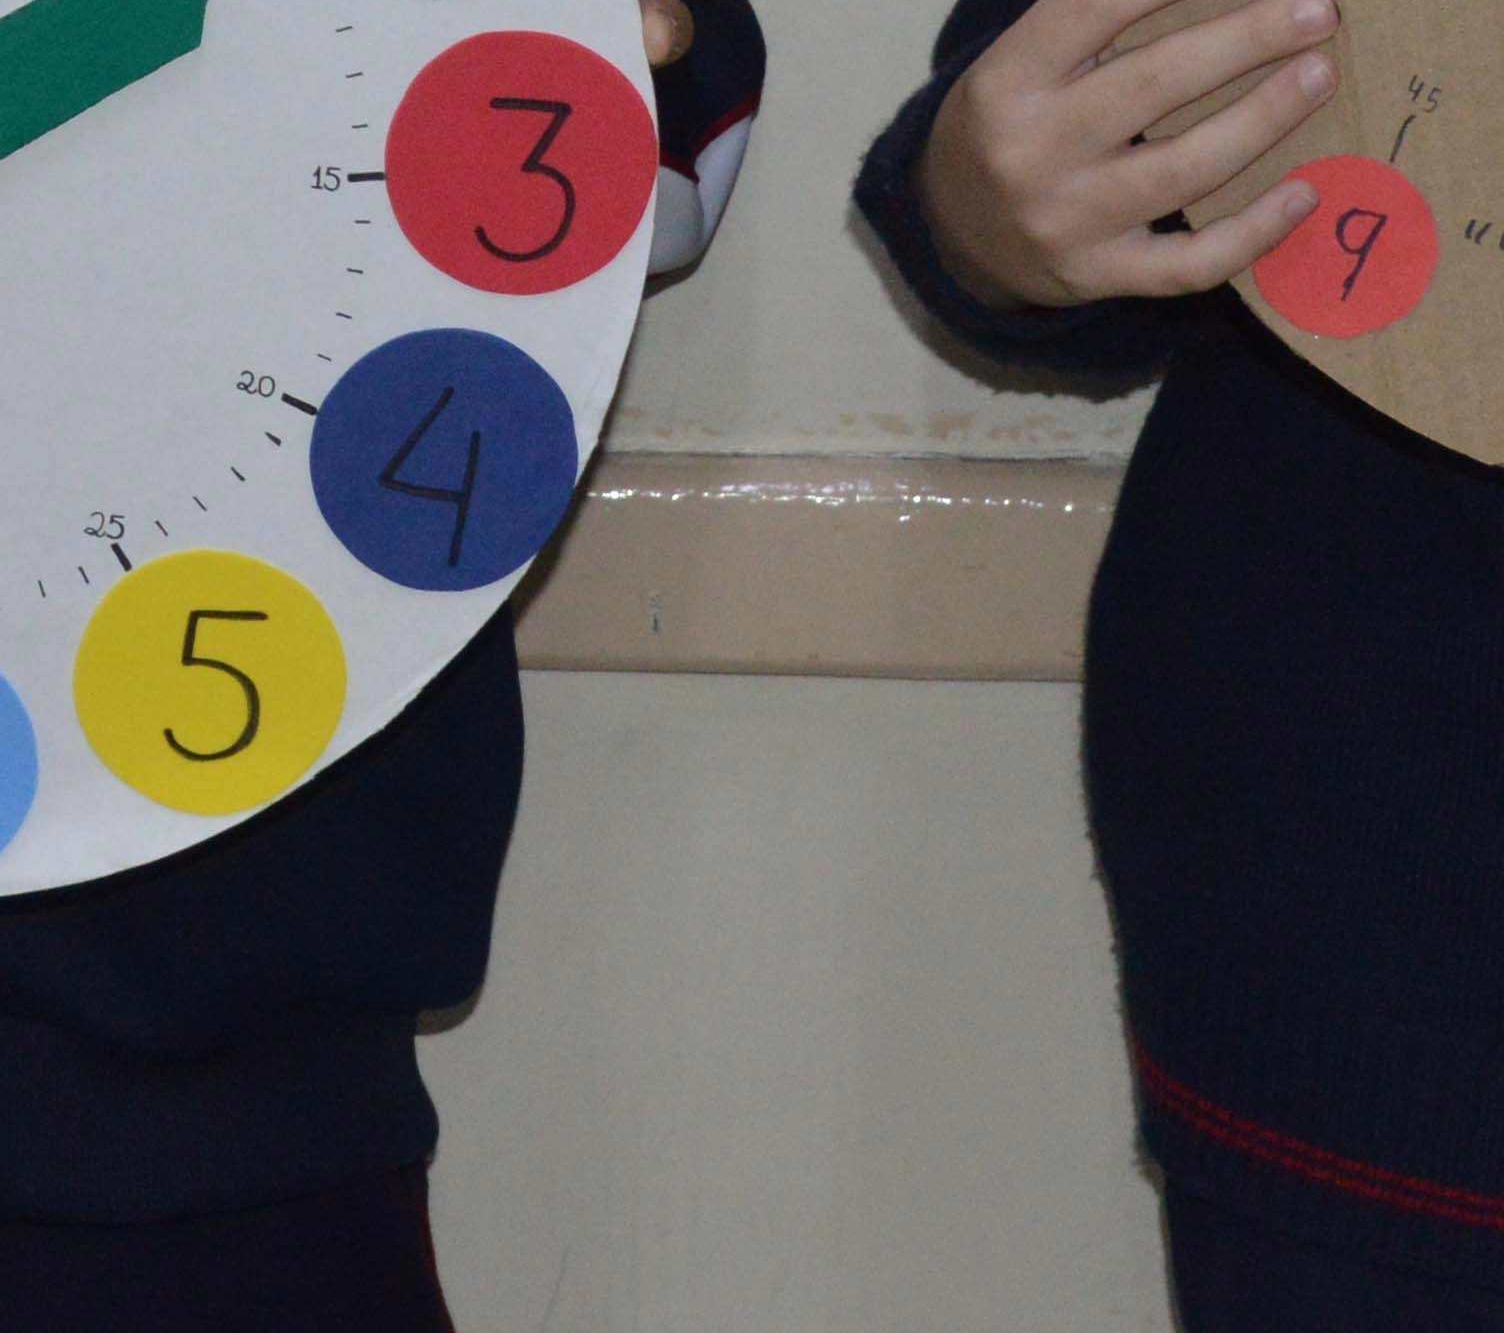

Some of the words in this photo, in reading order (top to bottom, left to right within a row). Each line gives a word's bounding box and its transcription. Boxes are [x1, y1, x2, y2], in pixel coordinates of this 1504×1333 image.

[1408, 74, 1442, 113] 45
[311, 166, 341, 193] 15
[474, 96, 576, 263] 3
[1335, 207, 1388, 300] 9
[236, 369, 276, 398] 20
[377, 386, 482, 567] 4
[83, 511, 125, 540] 25
[163, 609, 268, 763] 5
